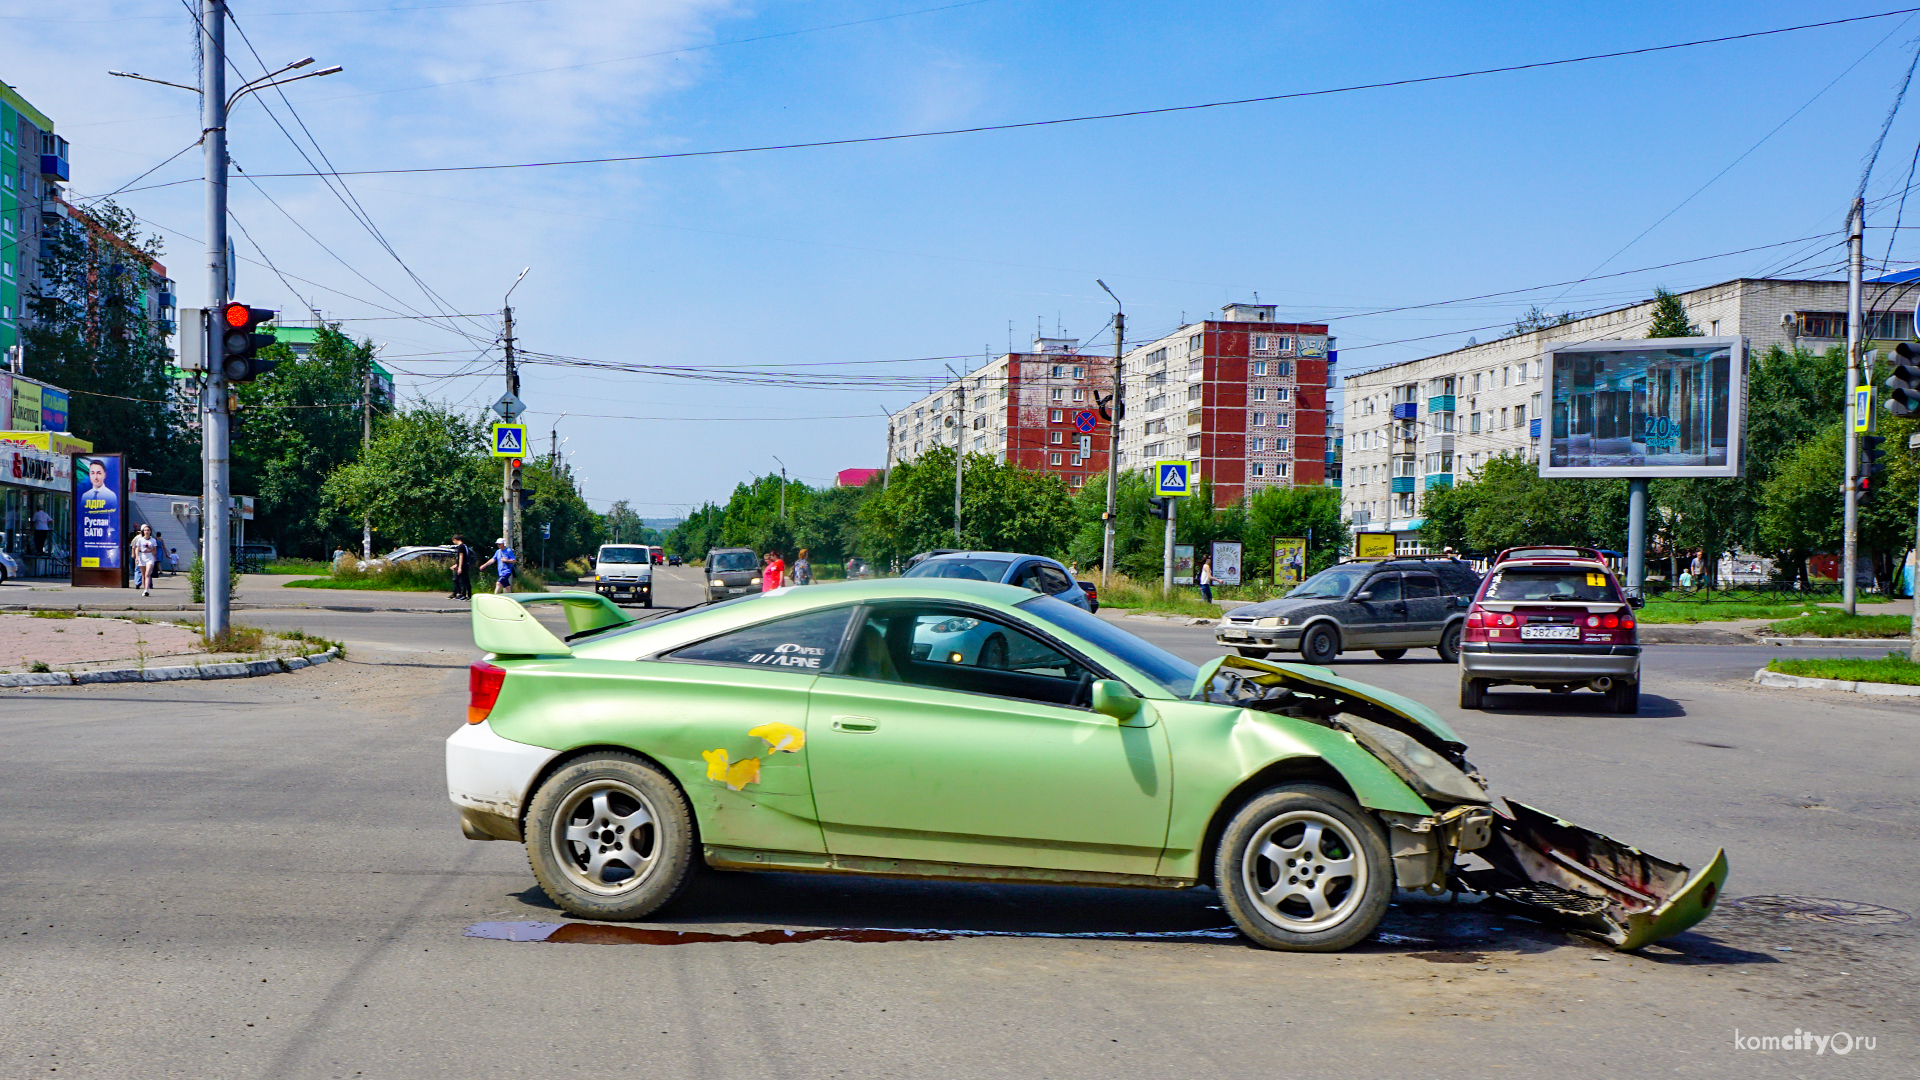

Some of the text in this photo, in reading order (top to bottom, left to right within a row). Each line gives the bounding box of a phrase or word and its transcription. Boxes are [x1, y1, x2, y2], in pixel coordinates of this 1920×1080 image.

[1645, 416, 1681, 437] 20%
[84, 499, 106, 509] ЛДПР
[84, 516, 109, 528] Руслан
[84, 527, 104, 537] БАТЮ
